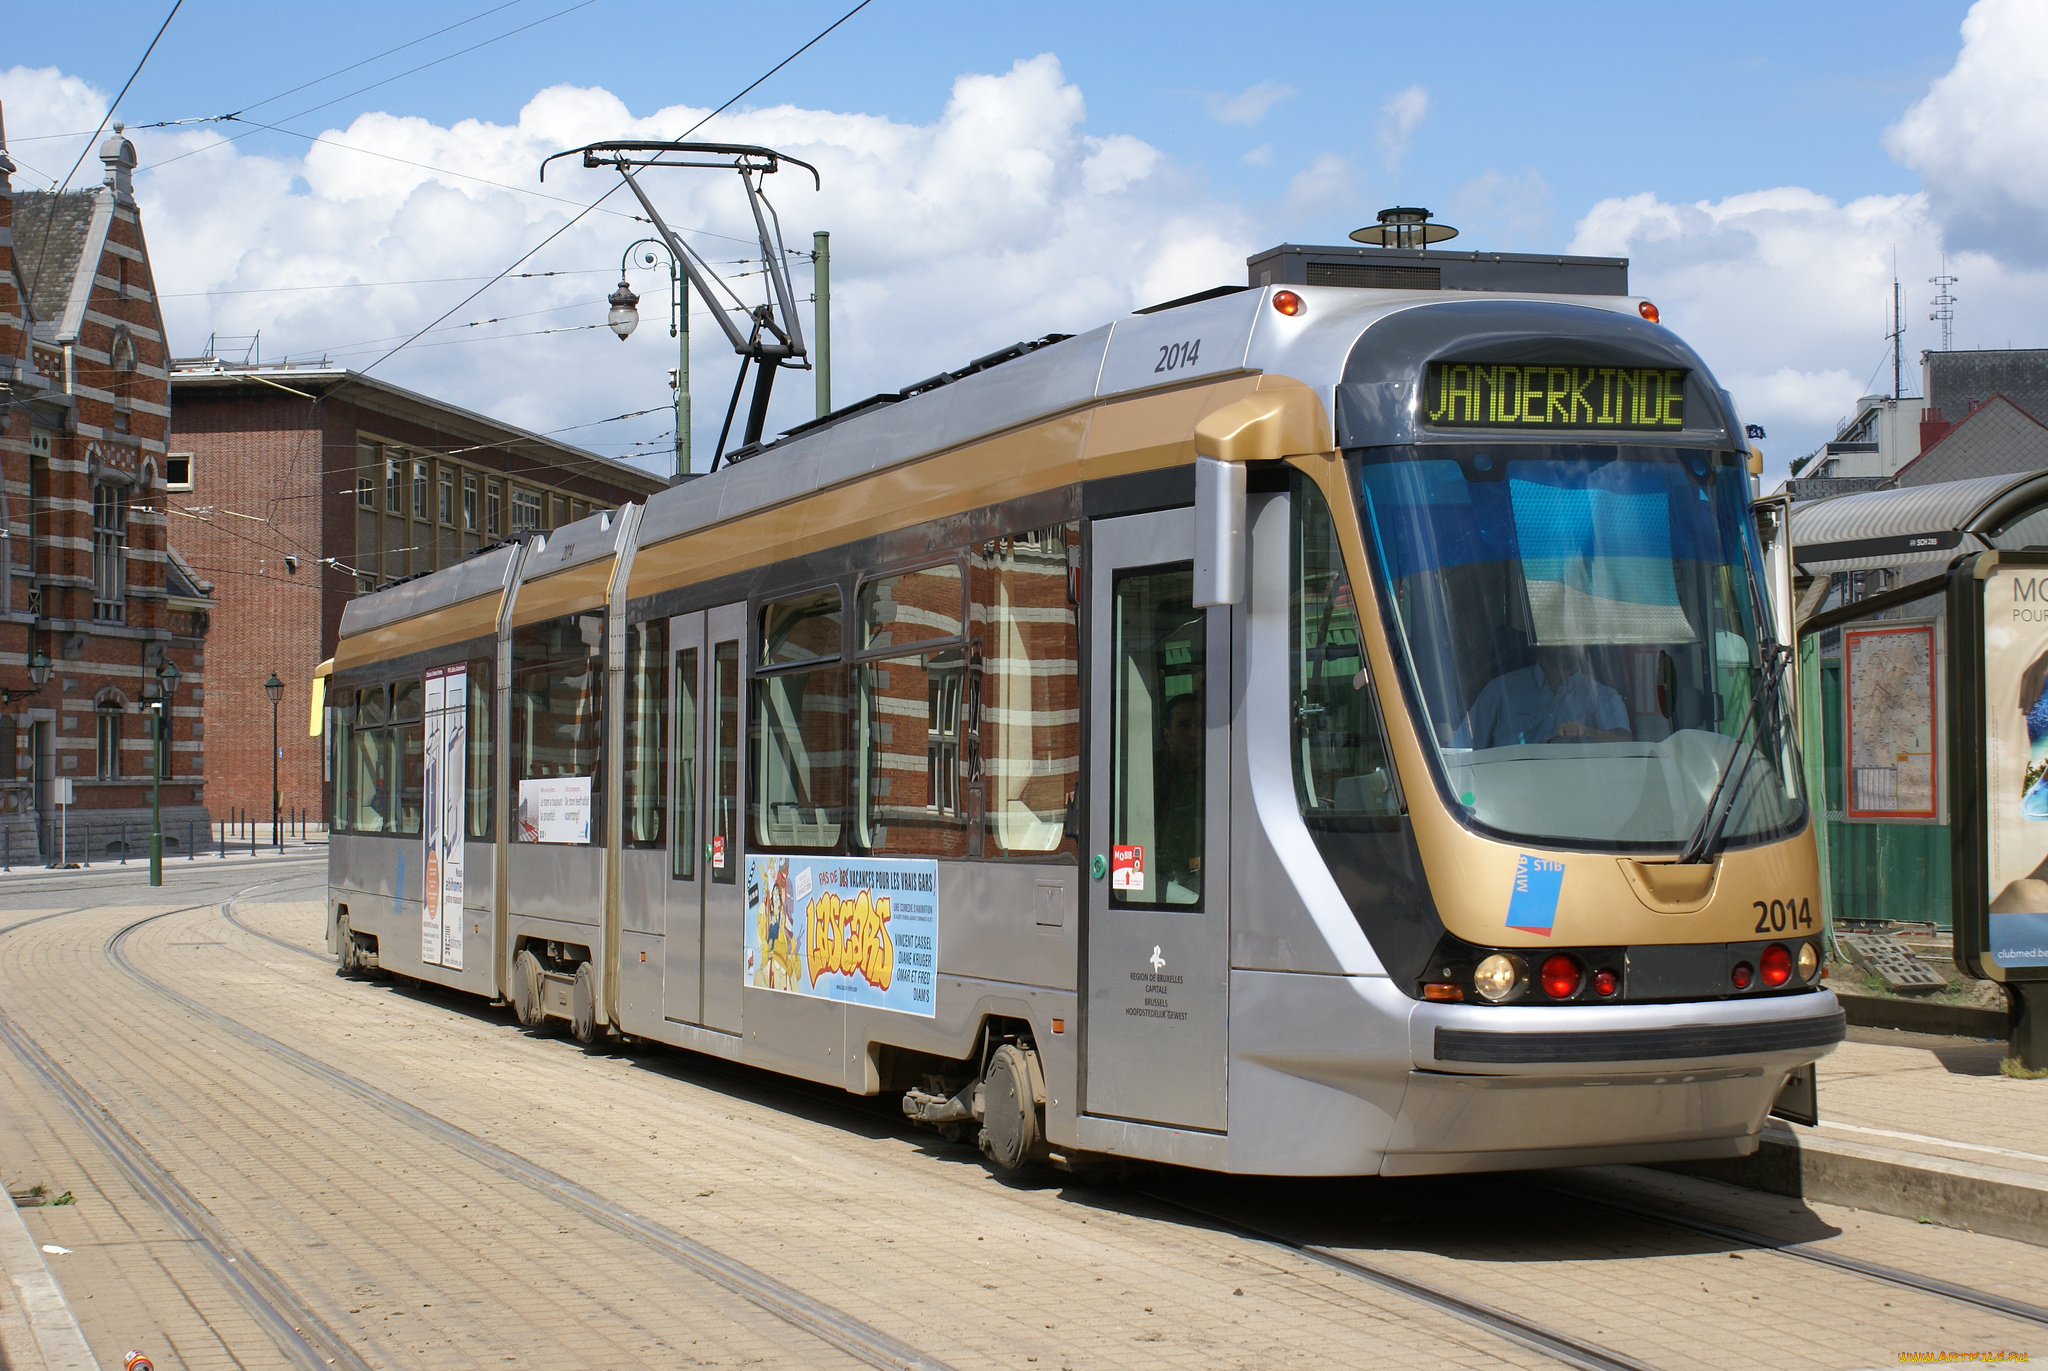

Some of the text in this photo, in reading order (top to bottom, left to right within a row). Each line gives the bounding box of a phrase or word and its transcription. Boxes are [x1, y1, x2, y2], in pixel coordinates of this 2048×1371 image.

[1154, 338, 1201, 373] 2014
[1916, 538, 1927, 546] SCH
[1114, 850, 1132, 861] MOBIB
[1533, 859, 1562, 872] STIB
[818, 871, 830, 885] PAS
[830, 869, 838, 883] DE
[849, 870, 875, 889] VACANCES
[876, 872, 889, 889] POUR
[891, 872, 900, 890] LES
[901, 873, 917, 891] VRAIS
[918, 874, 933, 892] GARS
[1516, 856, 1528, 892] MIVB
[1753, 897, 1812, 934] 2014
[895, 933, 932, 950] VINCENT CASSEL
[898, 951, 932, 967] DIANE KRUGER
[1997, 947, 2048, 959] clubmed.be
[897, 968, 931, 985] OMAR ET FRED
[1130, 972, 1184, 984] REGION DE BRUXELLES
[913, 987, 930, 1003] DIAM'S
[1145, 984, 1168, 994] CAPITALE
[1145, 998, 1168, 1007] BRUSSELS
[1125, 1008, 1188, 1020] HOOFDSTEDELIJK GEWEST
